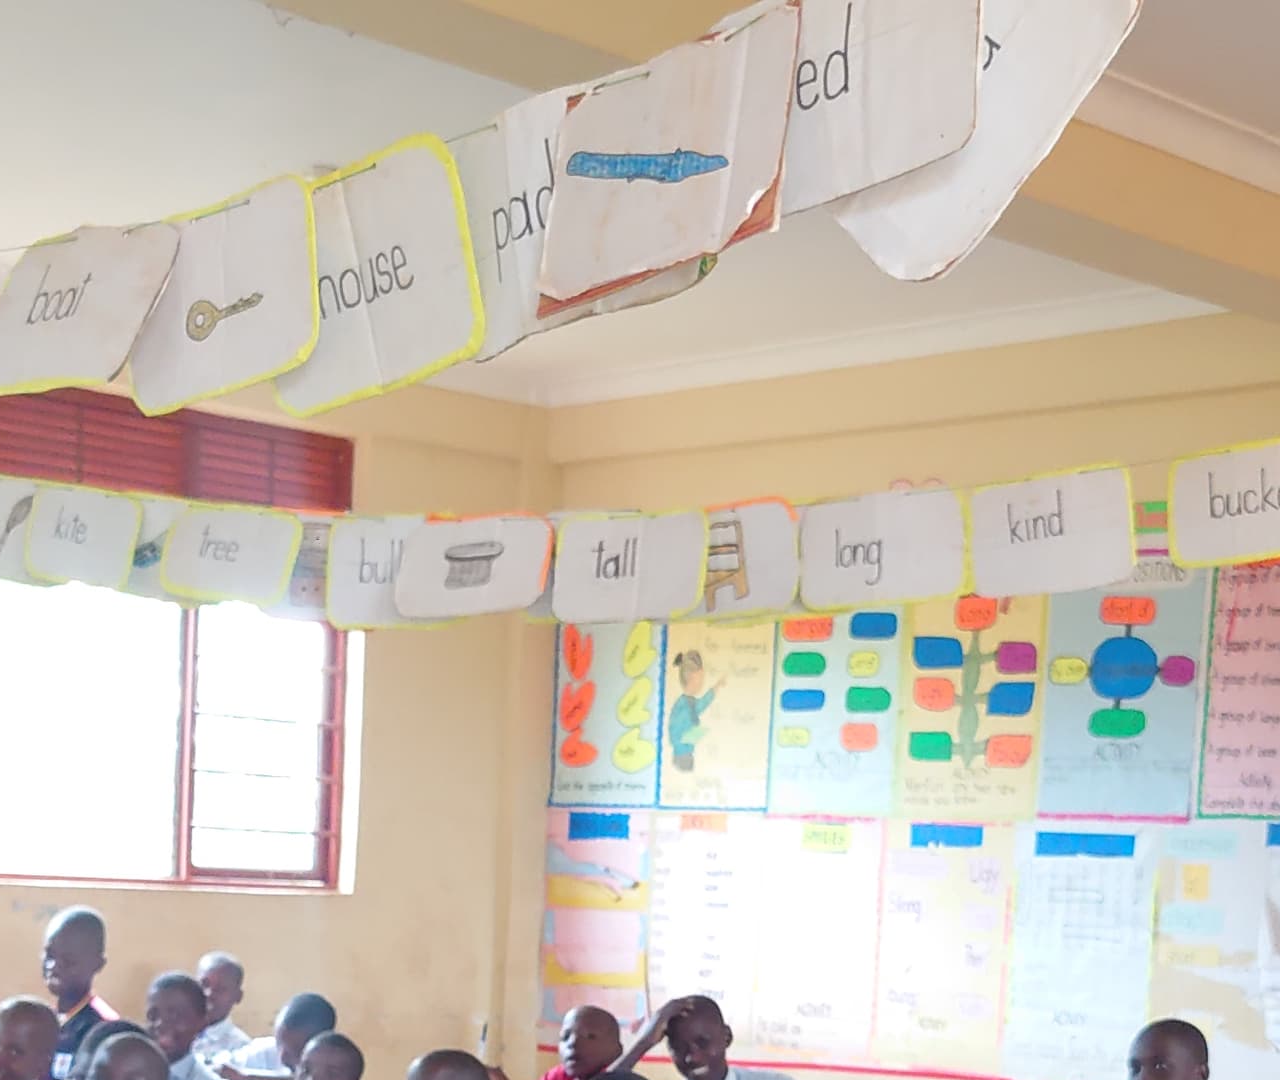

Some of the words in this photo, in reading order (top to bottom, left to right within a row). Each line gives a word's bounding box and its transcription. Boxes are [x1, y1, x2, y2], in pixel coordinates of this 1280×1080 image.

[796, 3, 852, 110] ed
[26, 264, 93, 326] boat
[54, 507, 89, 546] kite
[1008, 489, 1065, 545] kind
[198, 531, 240, 563] tree
[592, 537, 638, 580] tall
[833, 529, 883, 585] long
